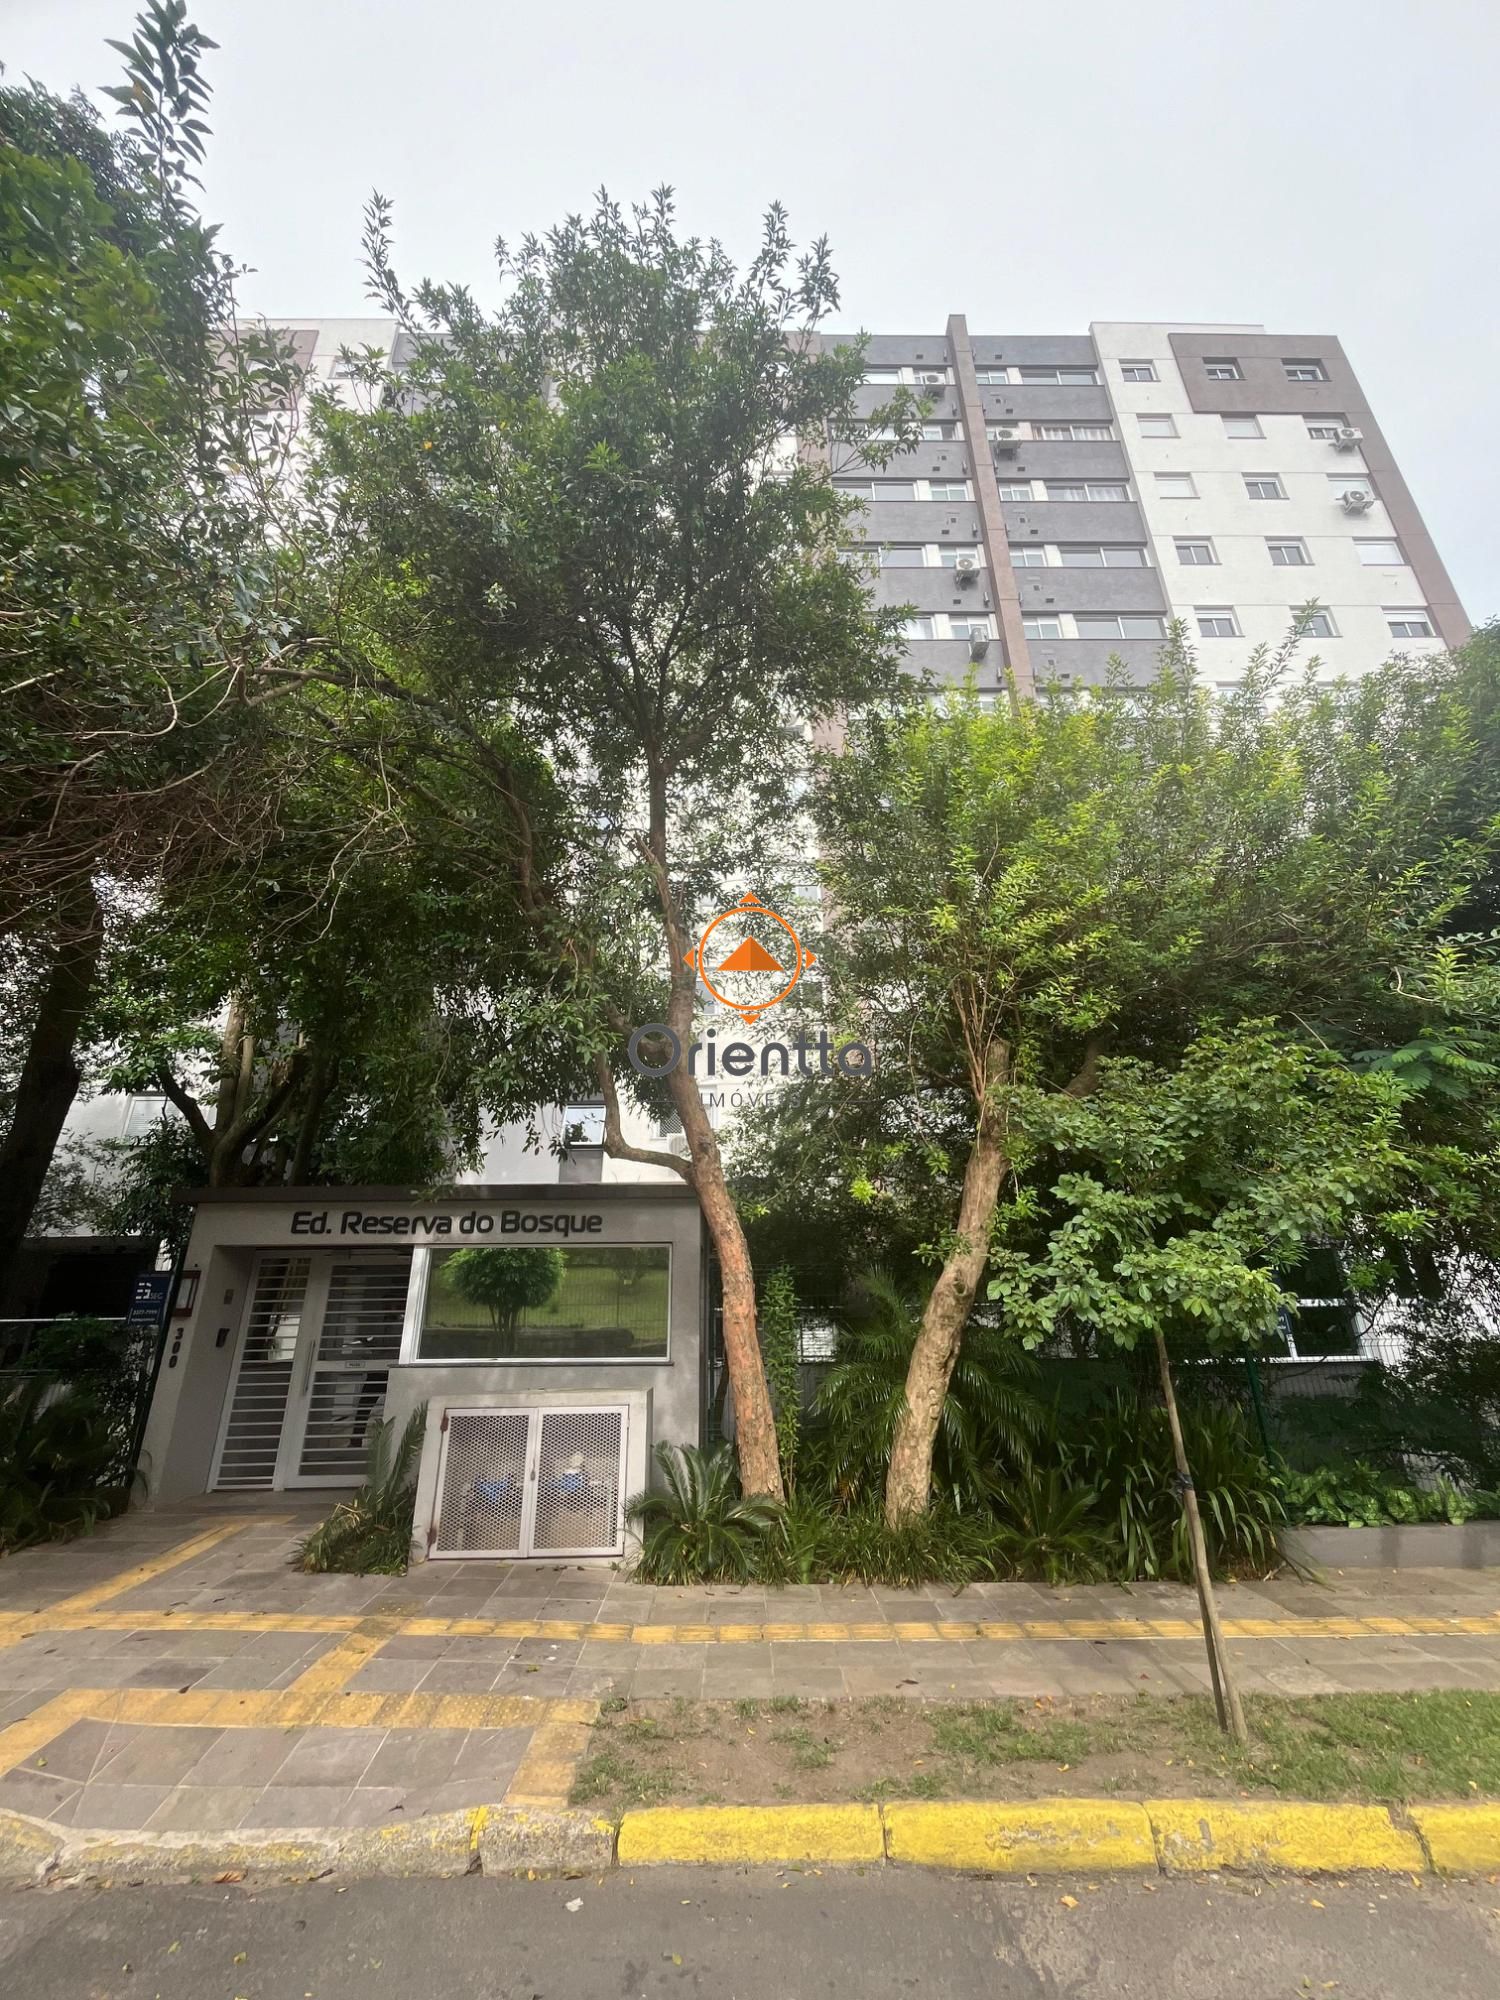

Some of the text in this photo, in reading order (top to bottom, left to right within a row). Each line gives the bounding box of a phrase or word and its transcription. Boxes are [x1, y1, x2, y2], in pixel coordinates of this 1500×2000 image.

[291, 1210, 602, 1236] Ed. Reserva do Bosque
[169, 1328, 184, 1368] 300
